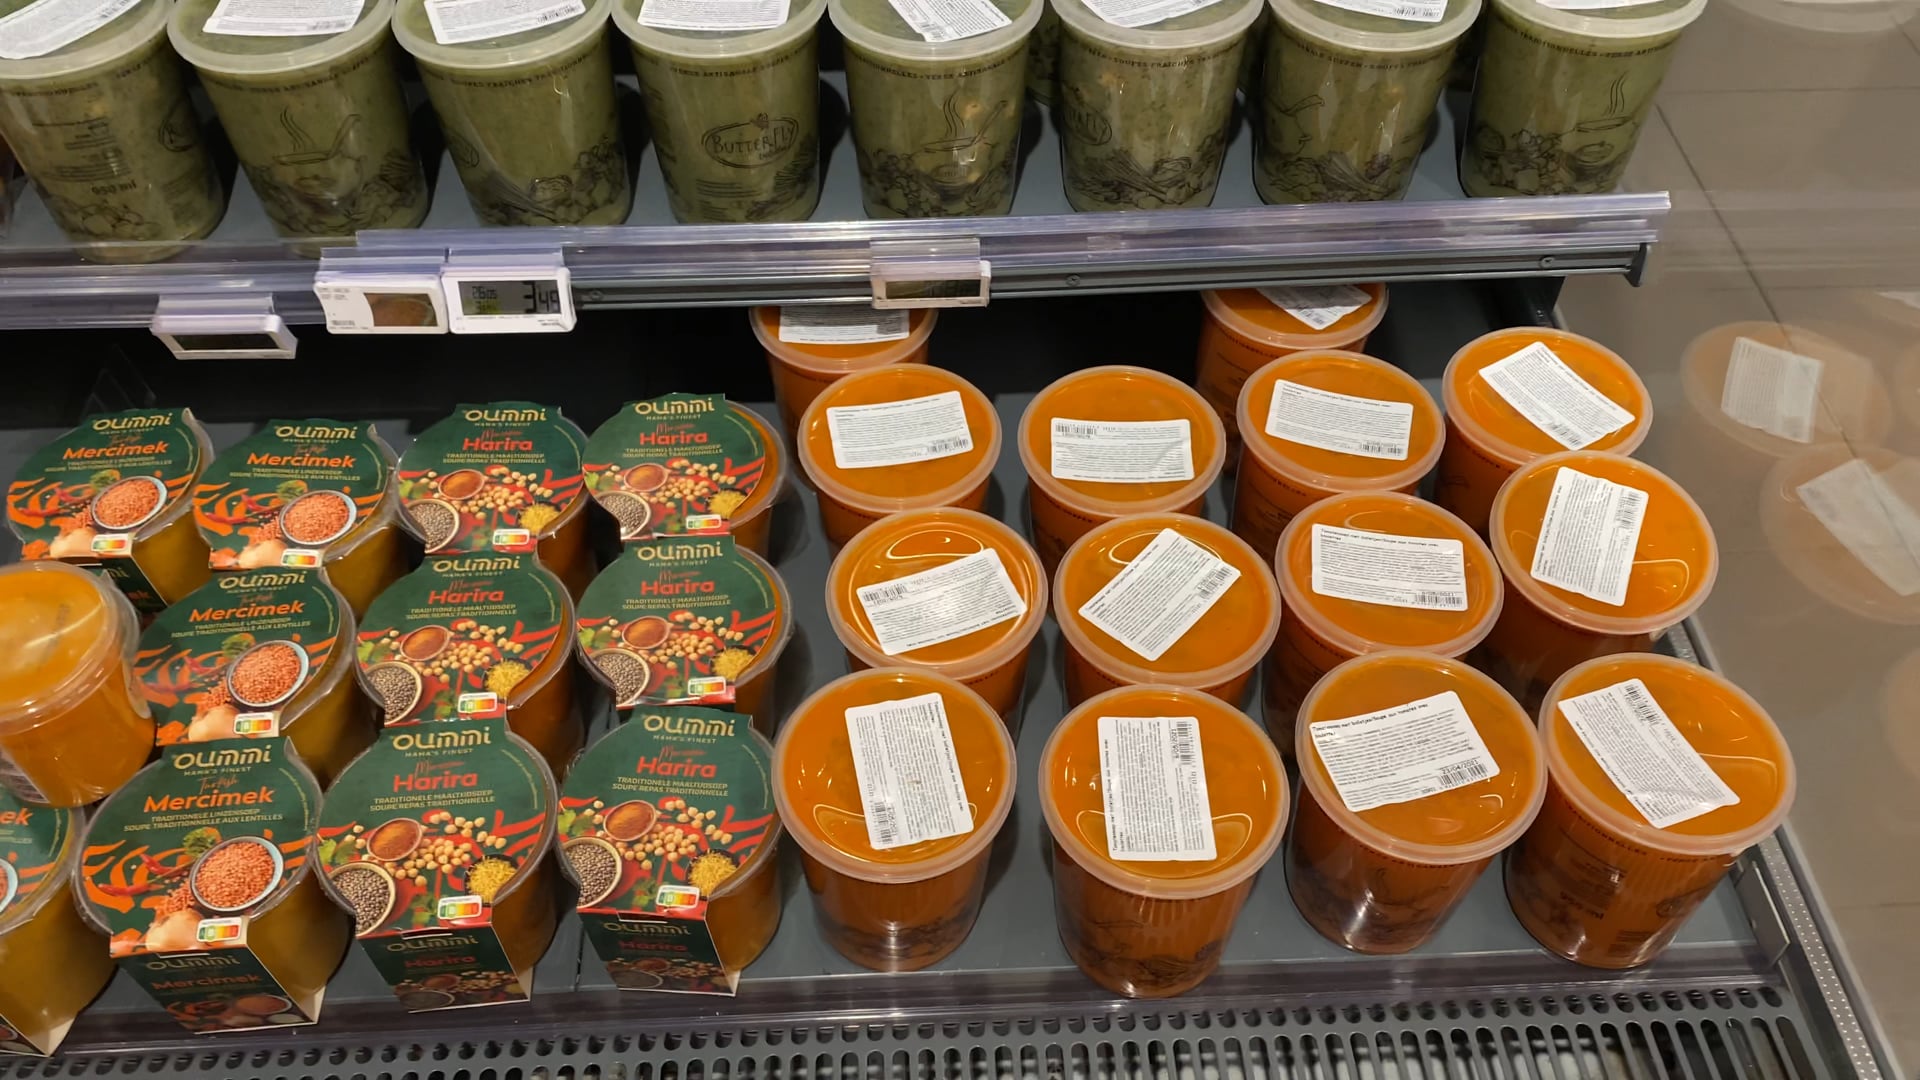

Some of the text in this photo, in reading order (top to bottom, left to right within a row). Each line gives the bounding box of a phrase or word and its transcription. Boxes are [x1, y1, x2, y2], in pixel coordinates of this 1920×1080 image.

[462, 437, 534, 451] Harira
[640, 431, 708, 446] Harira
[62, 441, 170, 460] Mercimek
[246, 452, 357, 468] Mercimek
[640, 579, 716, 595] Harira
[428, 588, 505, 605] Harira
[188, 600, 307, 622] Mercimek
[636, 756, 718, 778] Harira
[393, 770, 479, 793] Harira
[143, 786, 276, 813] Mercimek
